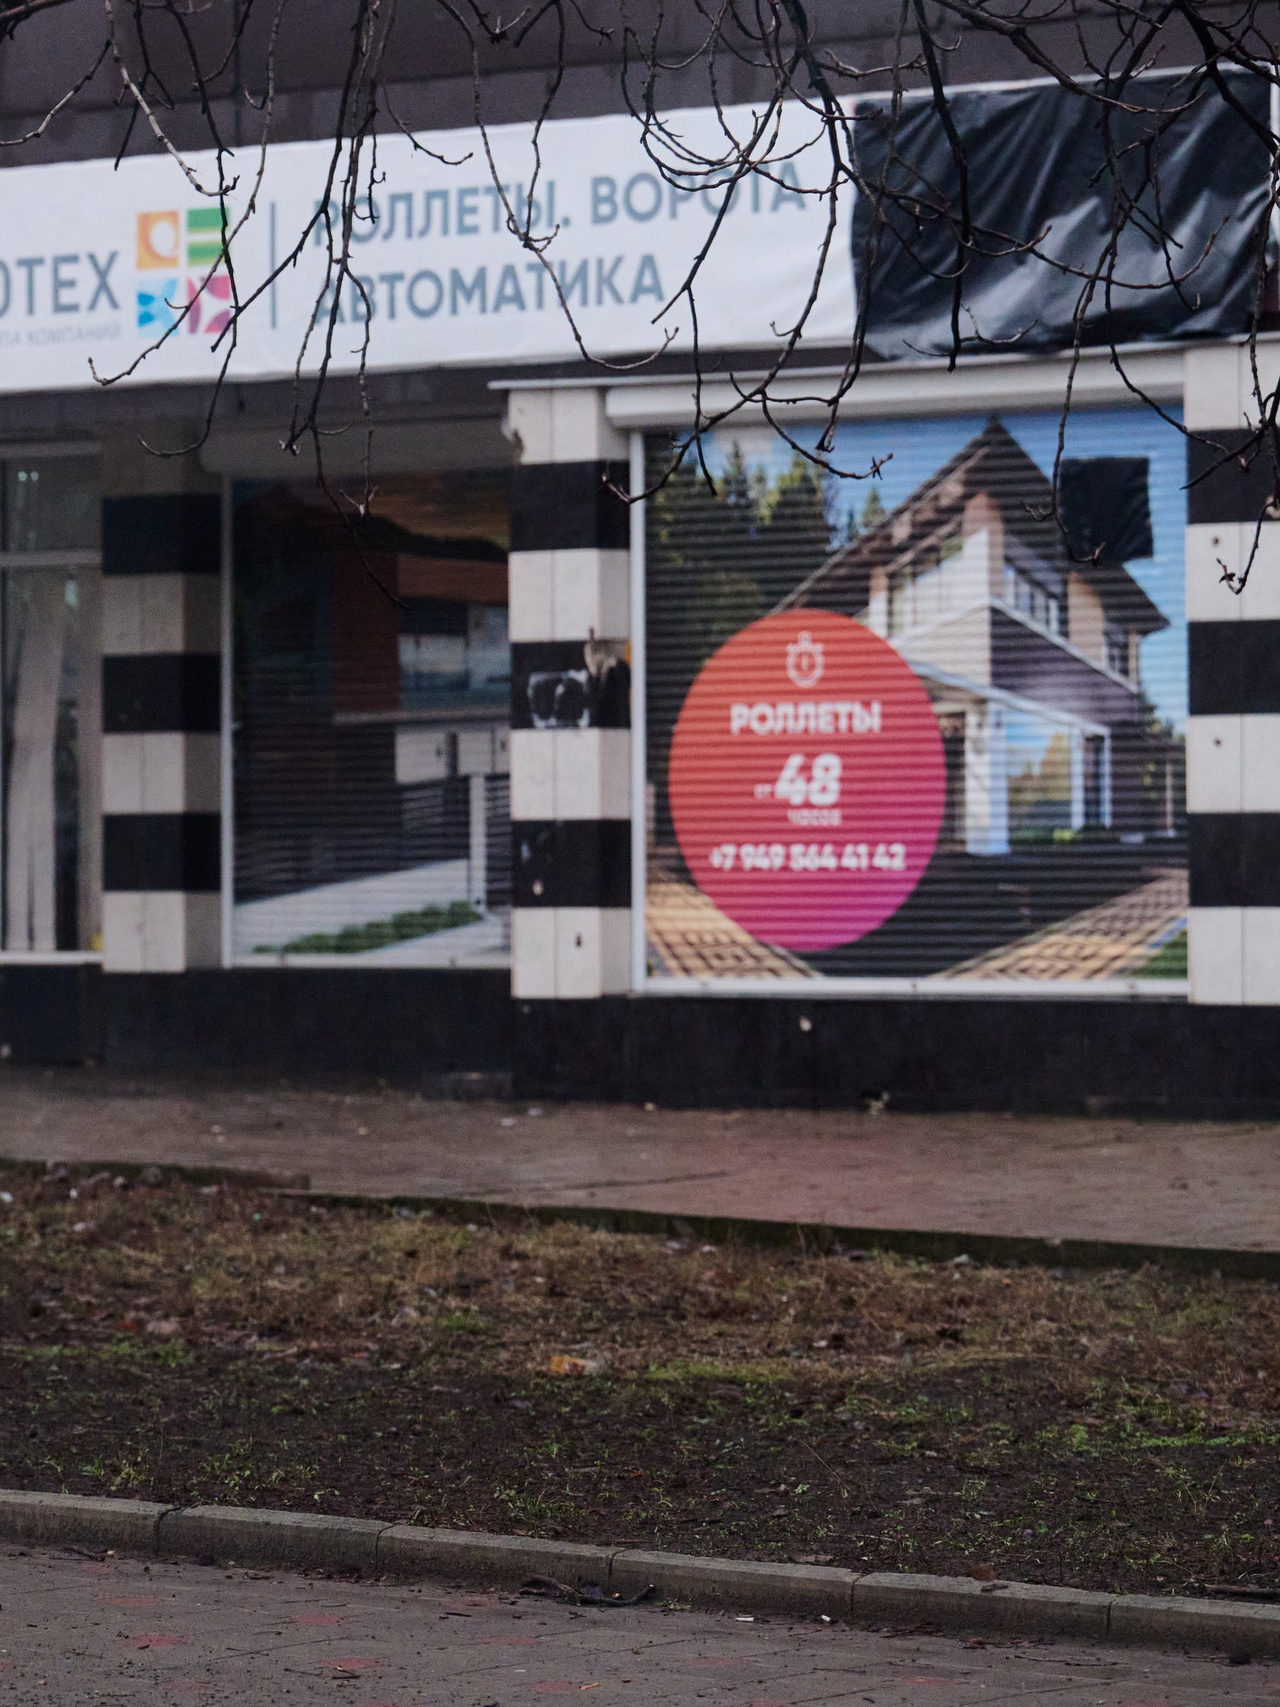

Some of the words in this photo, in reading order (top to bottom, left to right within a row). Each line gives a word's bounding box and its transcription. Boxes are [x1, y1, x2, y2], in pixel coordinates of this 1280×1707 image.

[591, 161, 807, 225] ВОРОТА
[314, 254, 665, 325] АВТОМАТИКА
[730, 701, 882, 735] РОЛЛЕТЫ
[774, 752, 843, 807] 48
[709, 843, 737, 870] +7
